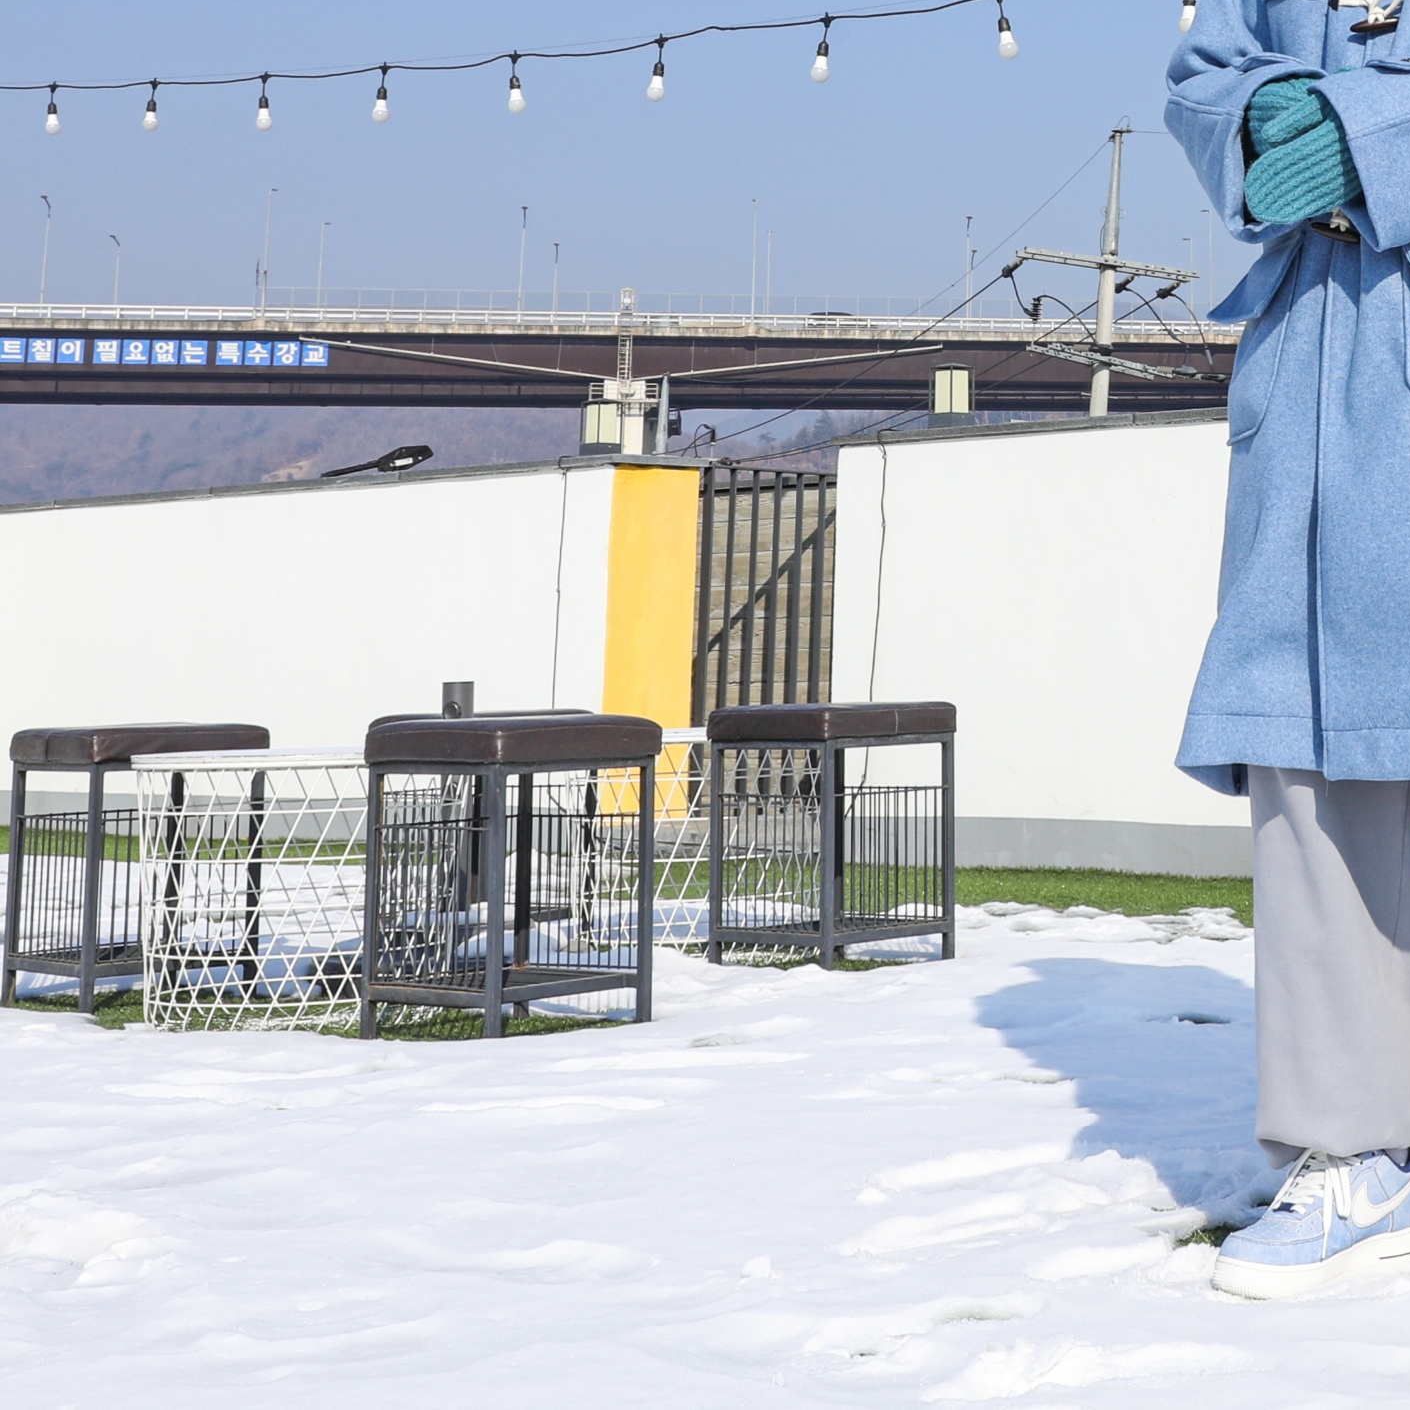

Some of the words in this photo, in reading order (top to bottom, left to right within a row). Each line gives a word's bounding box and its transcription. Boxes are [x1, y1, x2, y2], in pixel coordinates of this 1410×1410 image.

[0, 339, 81, 362] 트칠이
[96, 340, 205, 364] 필요없는
[218, 341, 326, 364] 특수강교
